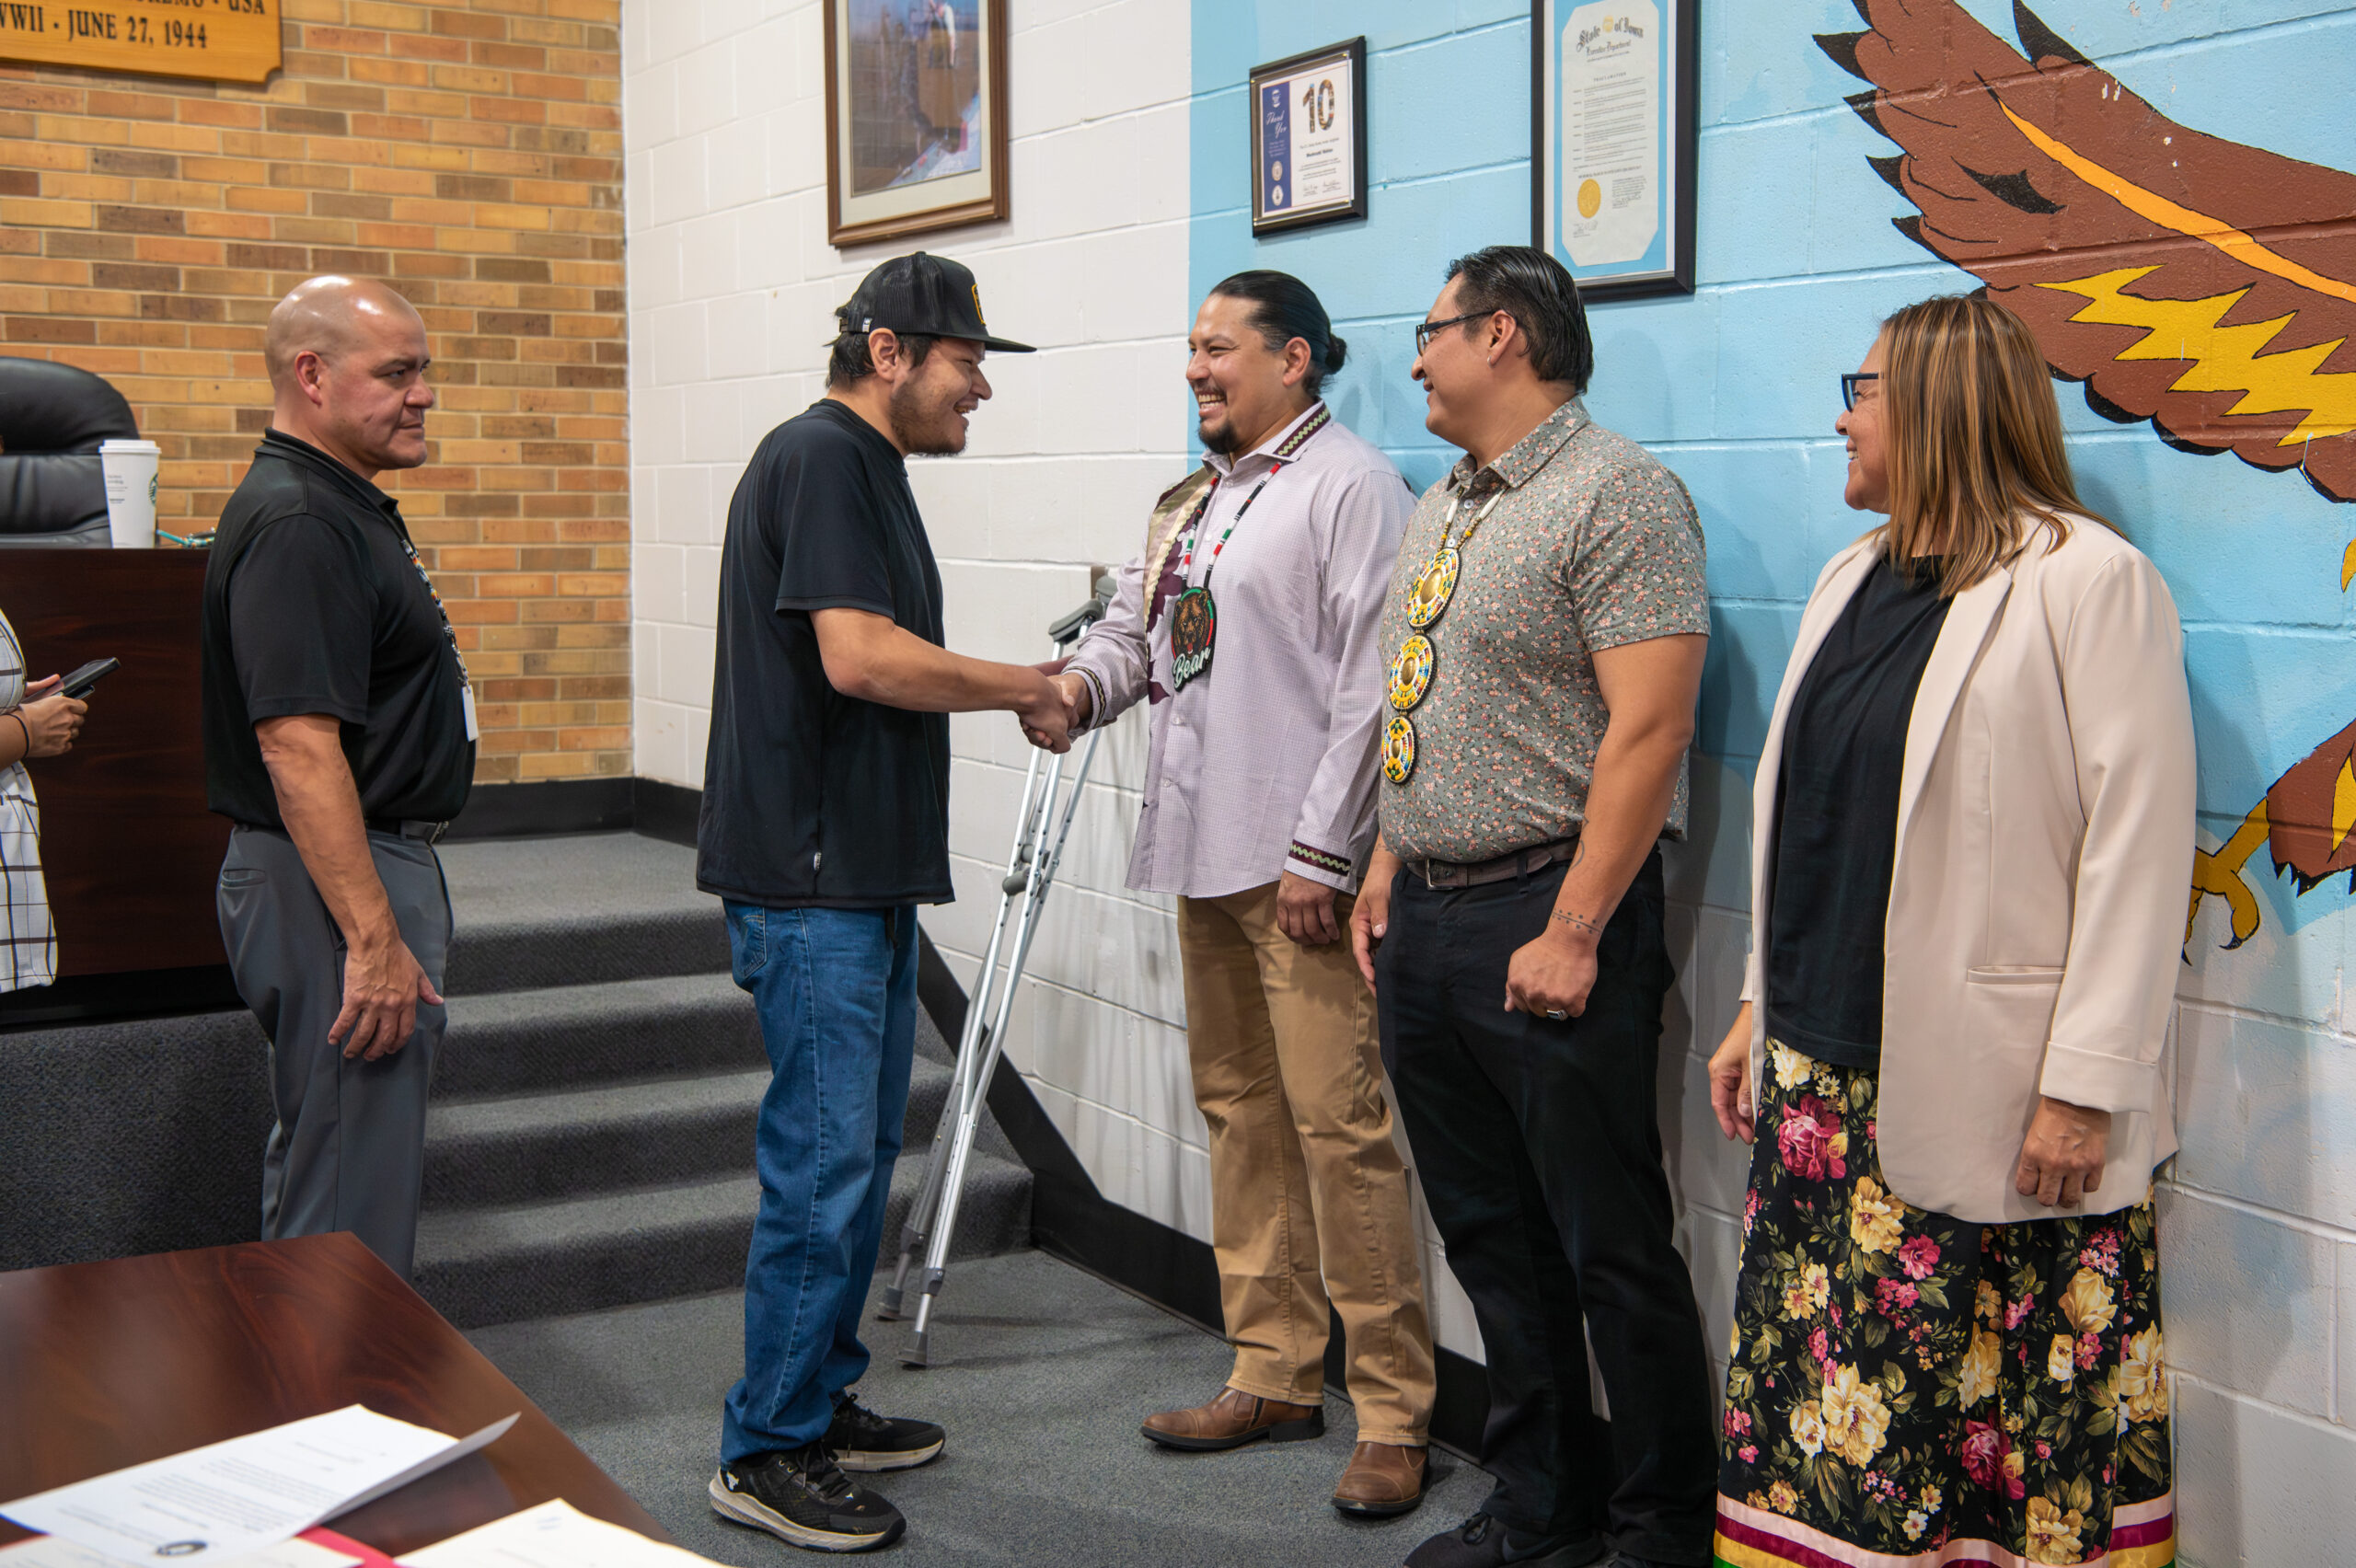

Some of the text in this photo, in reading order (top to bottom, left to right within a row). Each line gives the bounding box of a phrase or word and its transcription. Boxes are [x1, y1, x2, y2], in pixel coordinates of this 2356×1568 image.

[68, 9, 117, 42] JUNE
[127, 16, 154, 48] 27,
[165, 19, 207, 49] 1944
[1576, 17, 1644, 52] State of Iowa
[1302, 78, 1334, 133] 10
[1172, 647, 1211, 688] Bear
